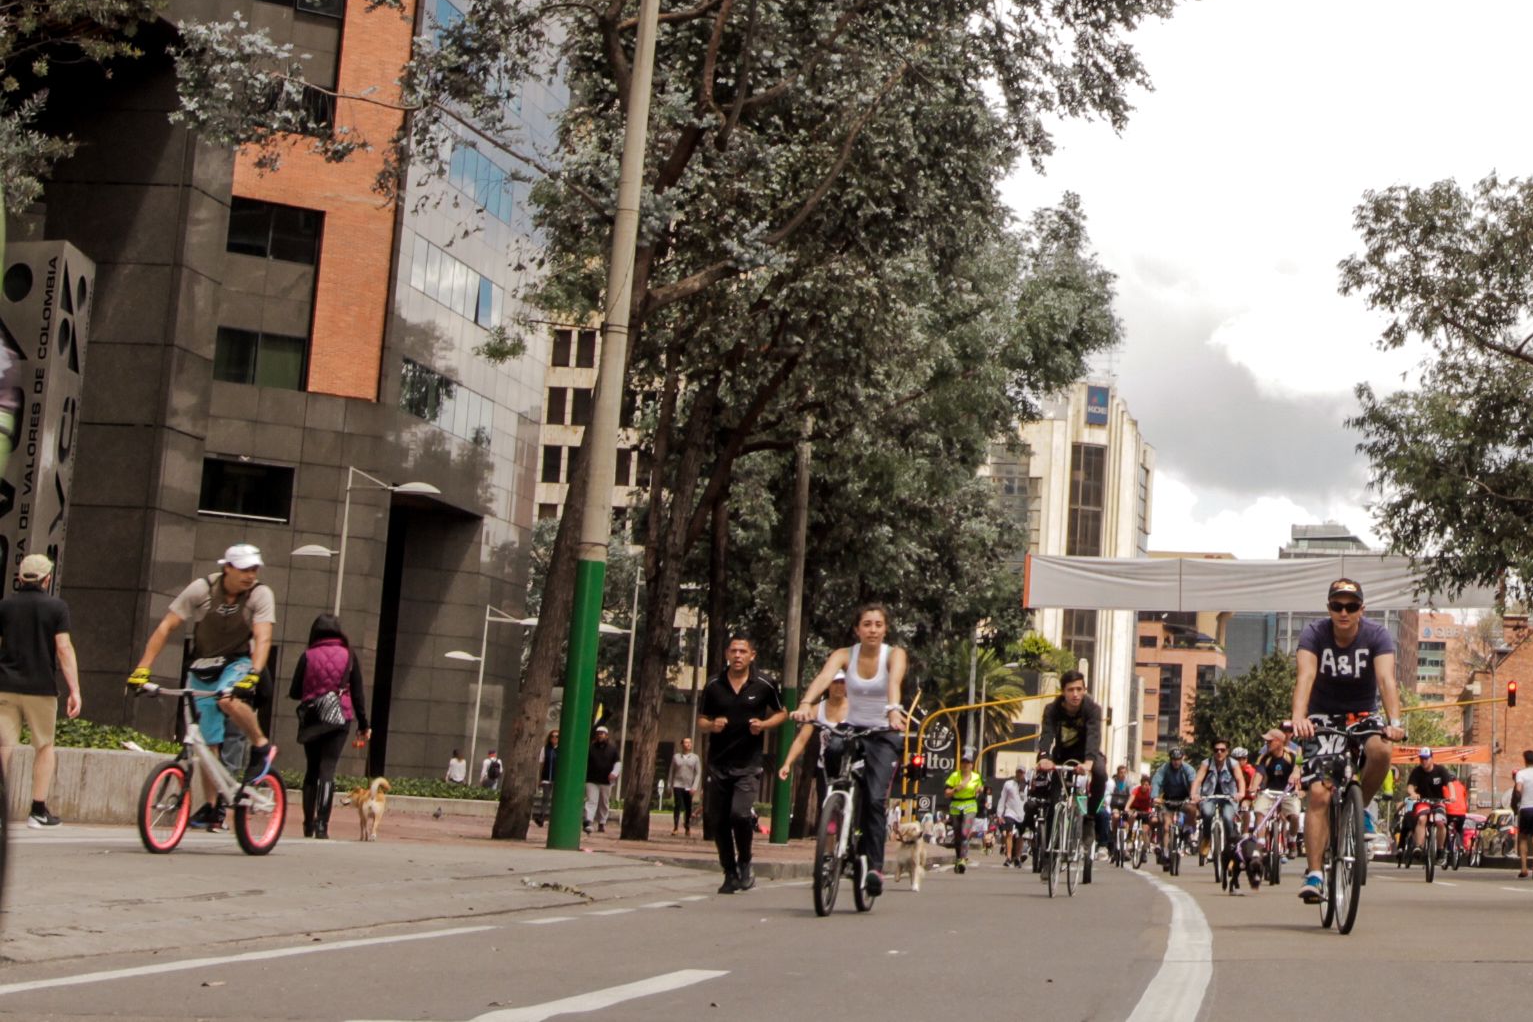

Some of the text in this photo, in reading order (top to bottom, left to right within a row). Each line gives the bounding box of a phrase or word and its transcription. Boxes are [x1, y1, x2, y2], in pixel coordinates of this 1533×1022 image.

[37, 255, 59, 360] COLOMBIA
[34, 368, 46, 394] DE
[22, 402, 42, 496] VALORES
[19, 502, 30, 530] DE
[1319, 647, 1370, 678] A&F
